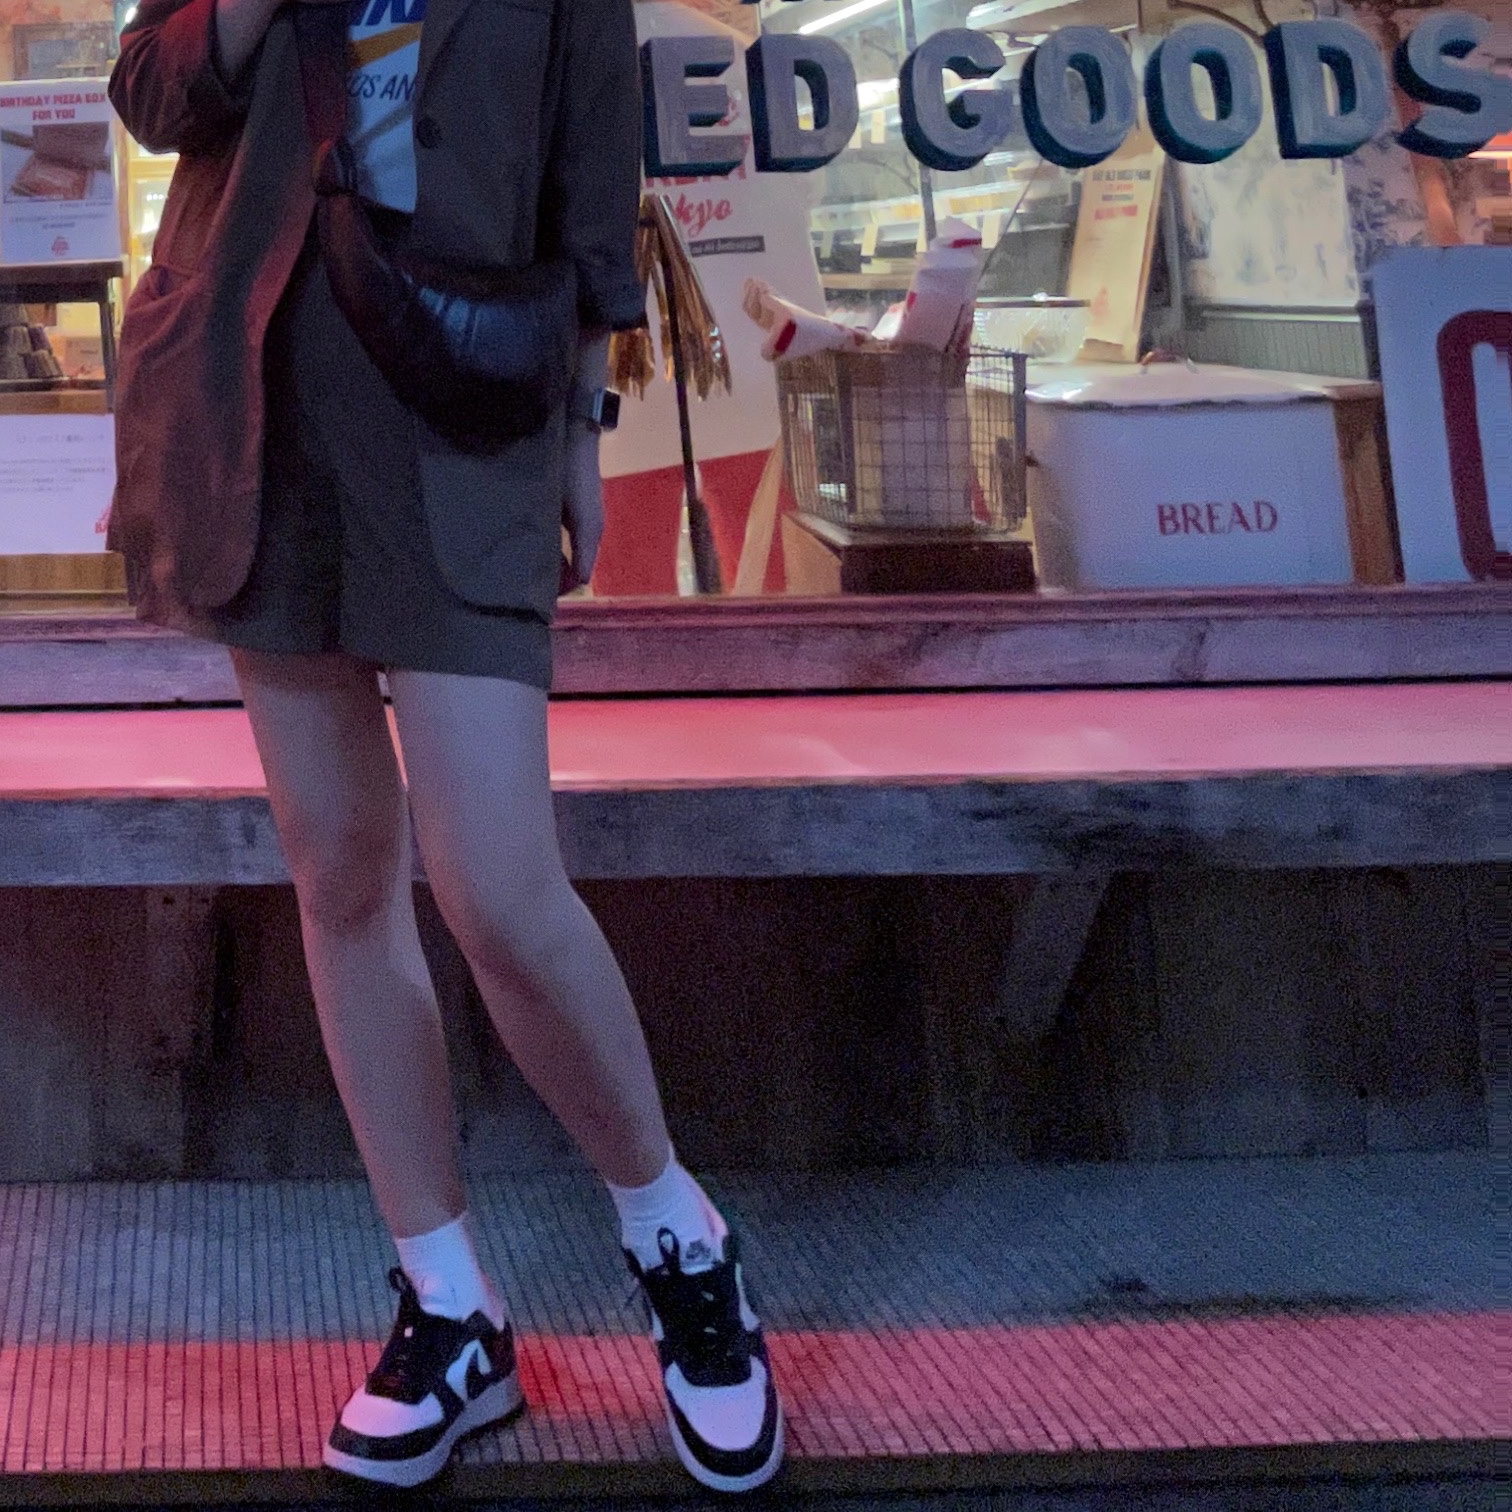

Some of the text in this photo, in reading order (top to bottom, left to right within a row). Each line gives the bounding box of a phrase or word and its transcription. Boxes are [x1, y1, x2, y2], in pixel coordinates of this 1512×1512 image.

[0, 95, 51, 108] BIRTHDAY
[53, 93, 83, 105] PIZZA
[899, 12, 1512, 173] GOODS
[32, 108, 76, 121] FOR YOU
[1157, 500, 1278, 536] BREAD
